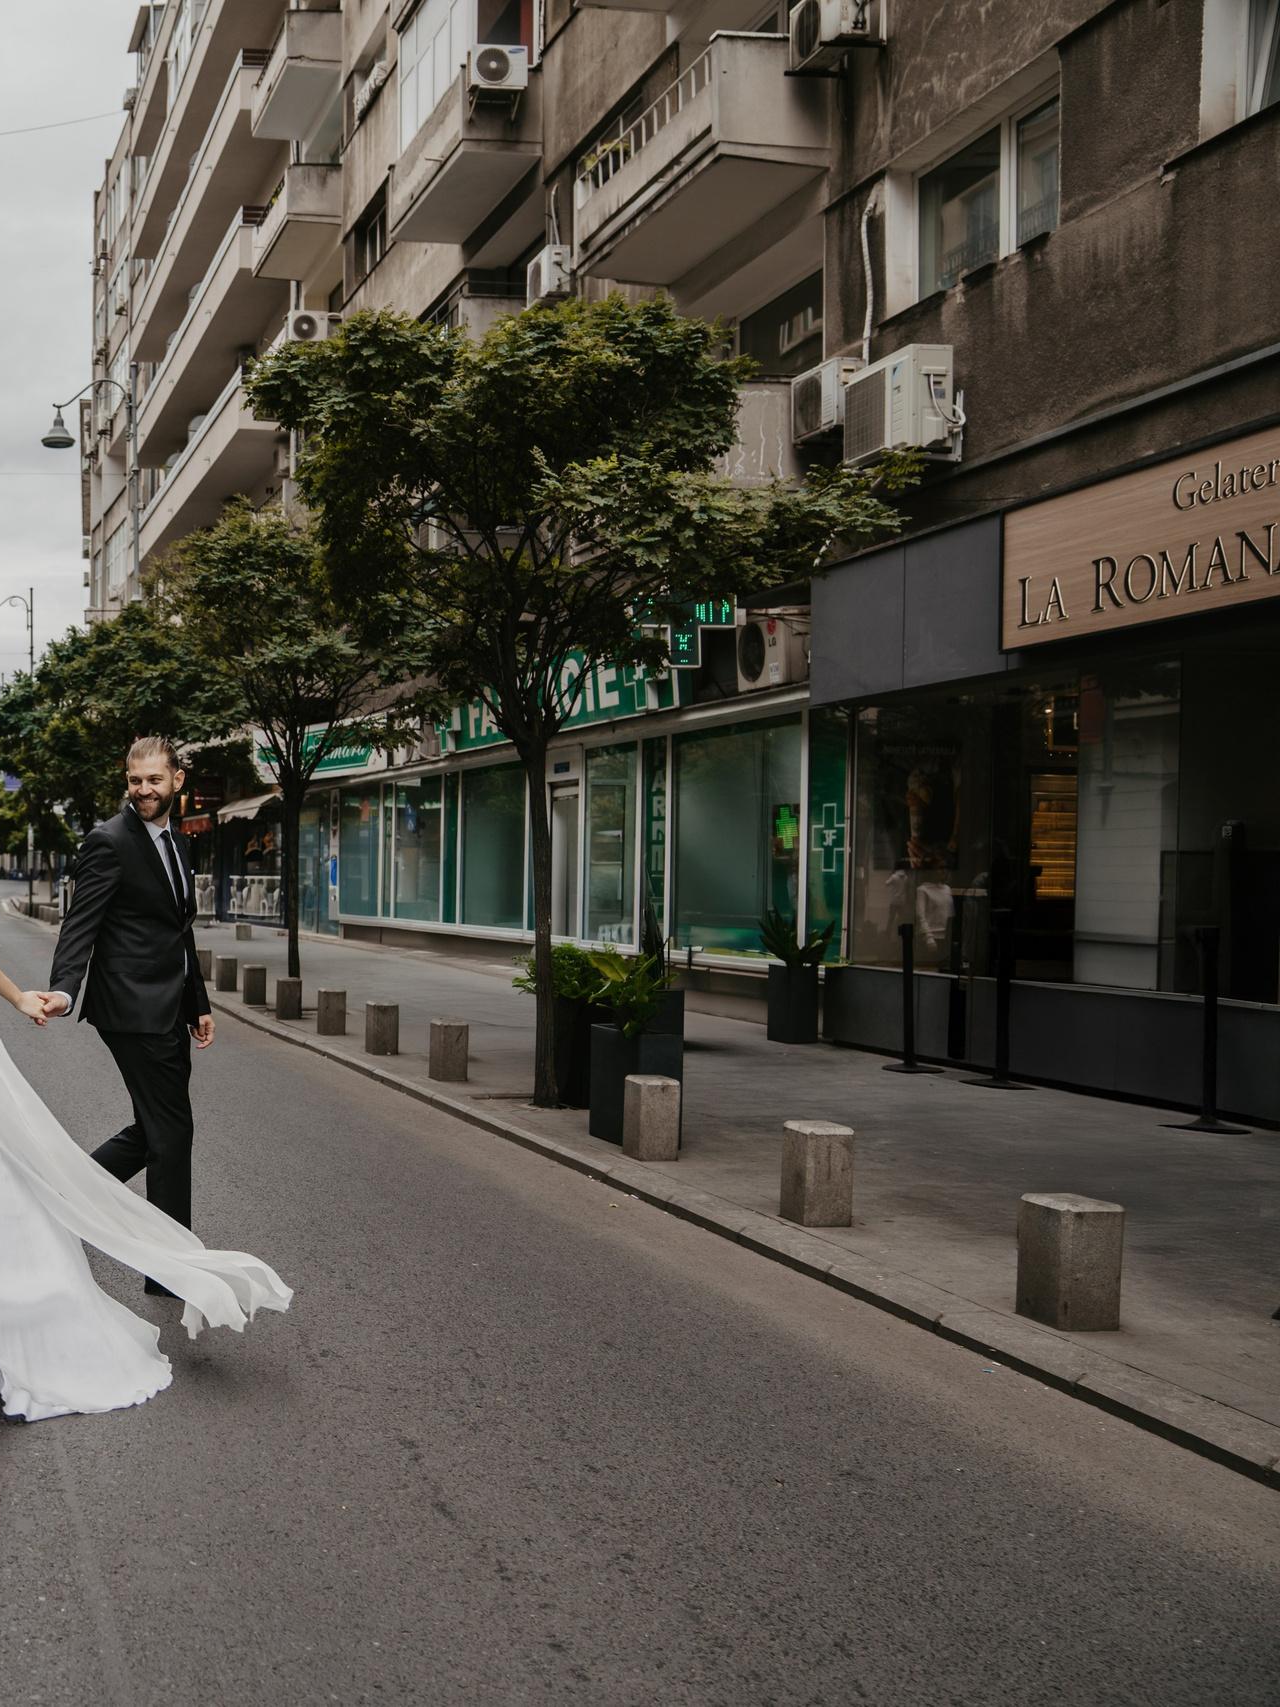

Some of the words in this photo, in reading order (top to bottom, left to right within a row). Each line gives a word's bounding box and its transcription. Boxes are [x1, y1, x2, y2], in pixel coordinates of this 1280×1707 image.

[1018, 575, 1069, 629] LA
[1091, 522, 1280, 614] ROMAN
[768, 637, 777, 647] LG
[822, 829, 837, 847] 3F
